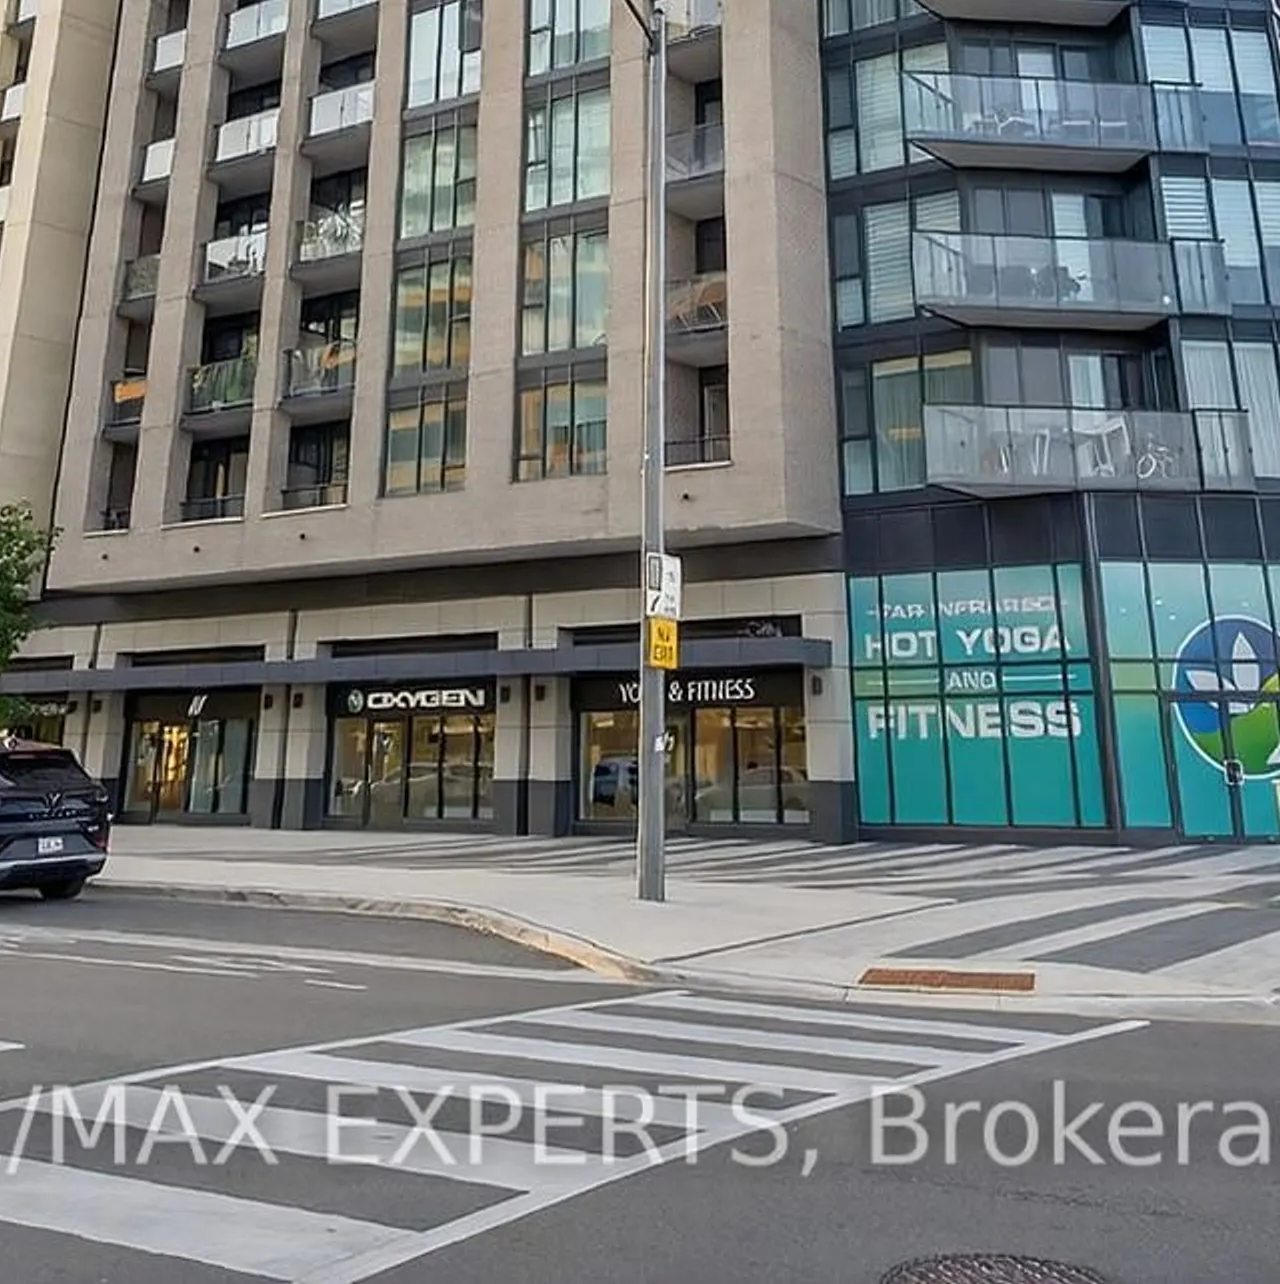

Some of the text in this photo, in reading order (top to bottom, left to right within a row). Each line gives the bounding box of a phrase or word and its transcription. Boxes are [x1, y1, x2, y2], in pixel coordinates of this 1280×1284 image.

[864, 624, 1071, 658] HOT YOGA
[668, 680, 684, 702] &
[687, 677, 756, 701] FITNESS
[946, 670, 997, 691] AND
[367, 688, 486, 709] OXYGEN
[867, 700, 1082, 740] FITNESS
